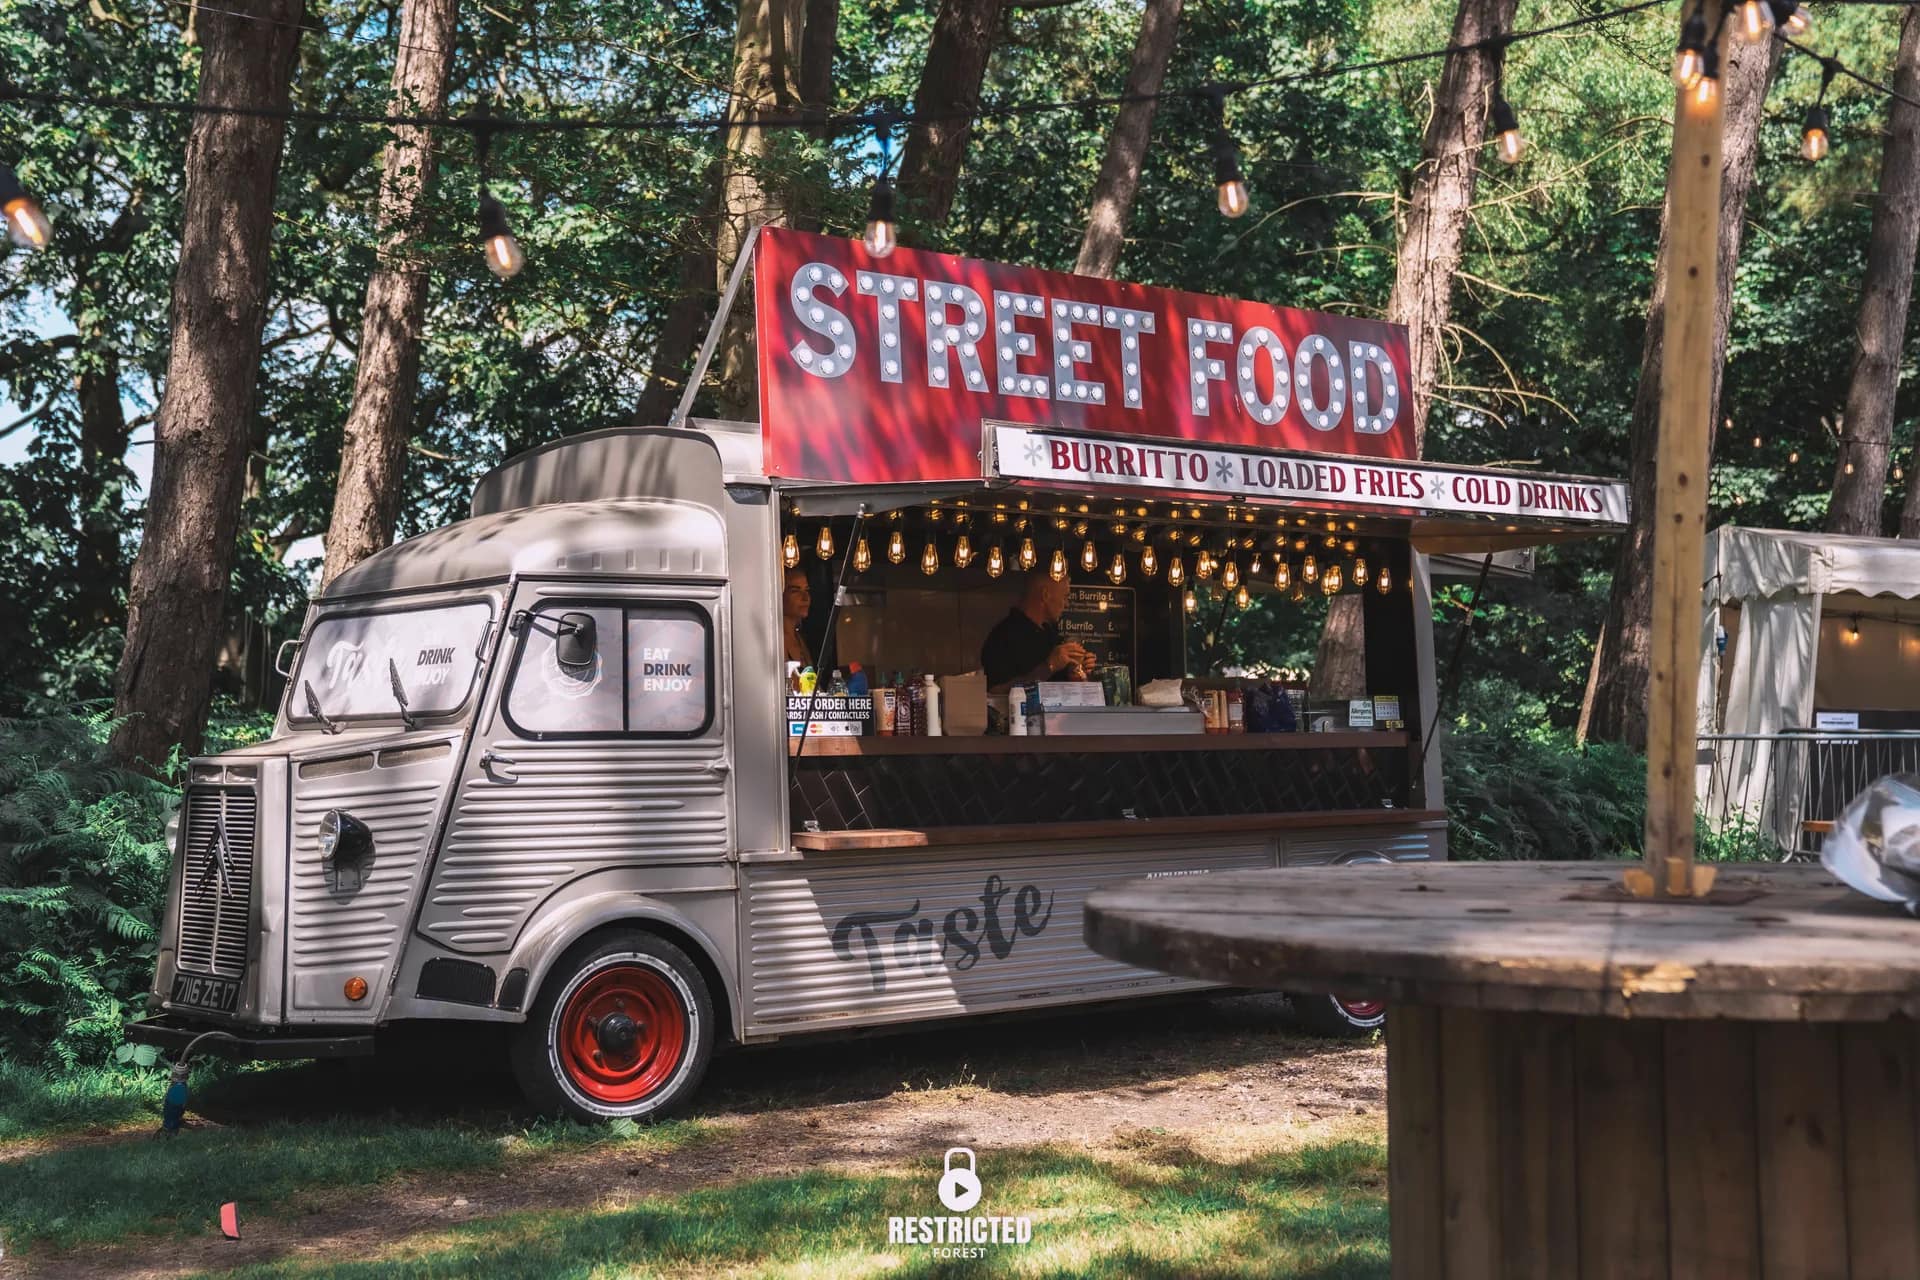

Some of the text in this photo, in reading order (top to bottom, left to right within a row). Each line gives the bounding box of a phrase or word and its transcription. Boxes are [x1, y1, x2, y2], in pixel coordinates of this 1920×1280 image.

[790, 262, 1399, 434] STREET FOOD
[1051, 440, 1209, 483] BURRITTO
[1242, 458, 1425, 500] LOADED FRIES
[1453, 476, 1603, 514] COLD DRINKS
[417, 647, 456, 666] DRINK
[643, 647, 672, 661] EAT
[643, 663, 692, 677] DRINK
[643, 679, 693, 692] ENJOY
[814, 698, 847, 710] ORDER
[848, 698, 872, 710] HERE
[828, 711, 870, 720] CONTACTLESS
[831, 874, 1055, 992] Taste
[176, 977, 238, 1010] 7116 ZE 17
